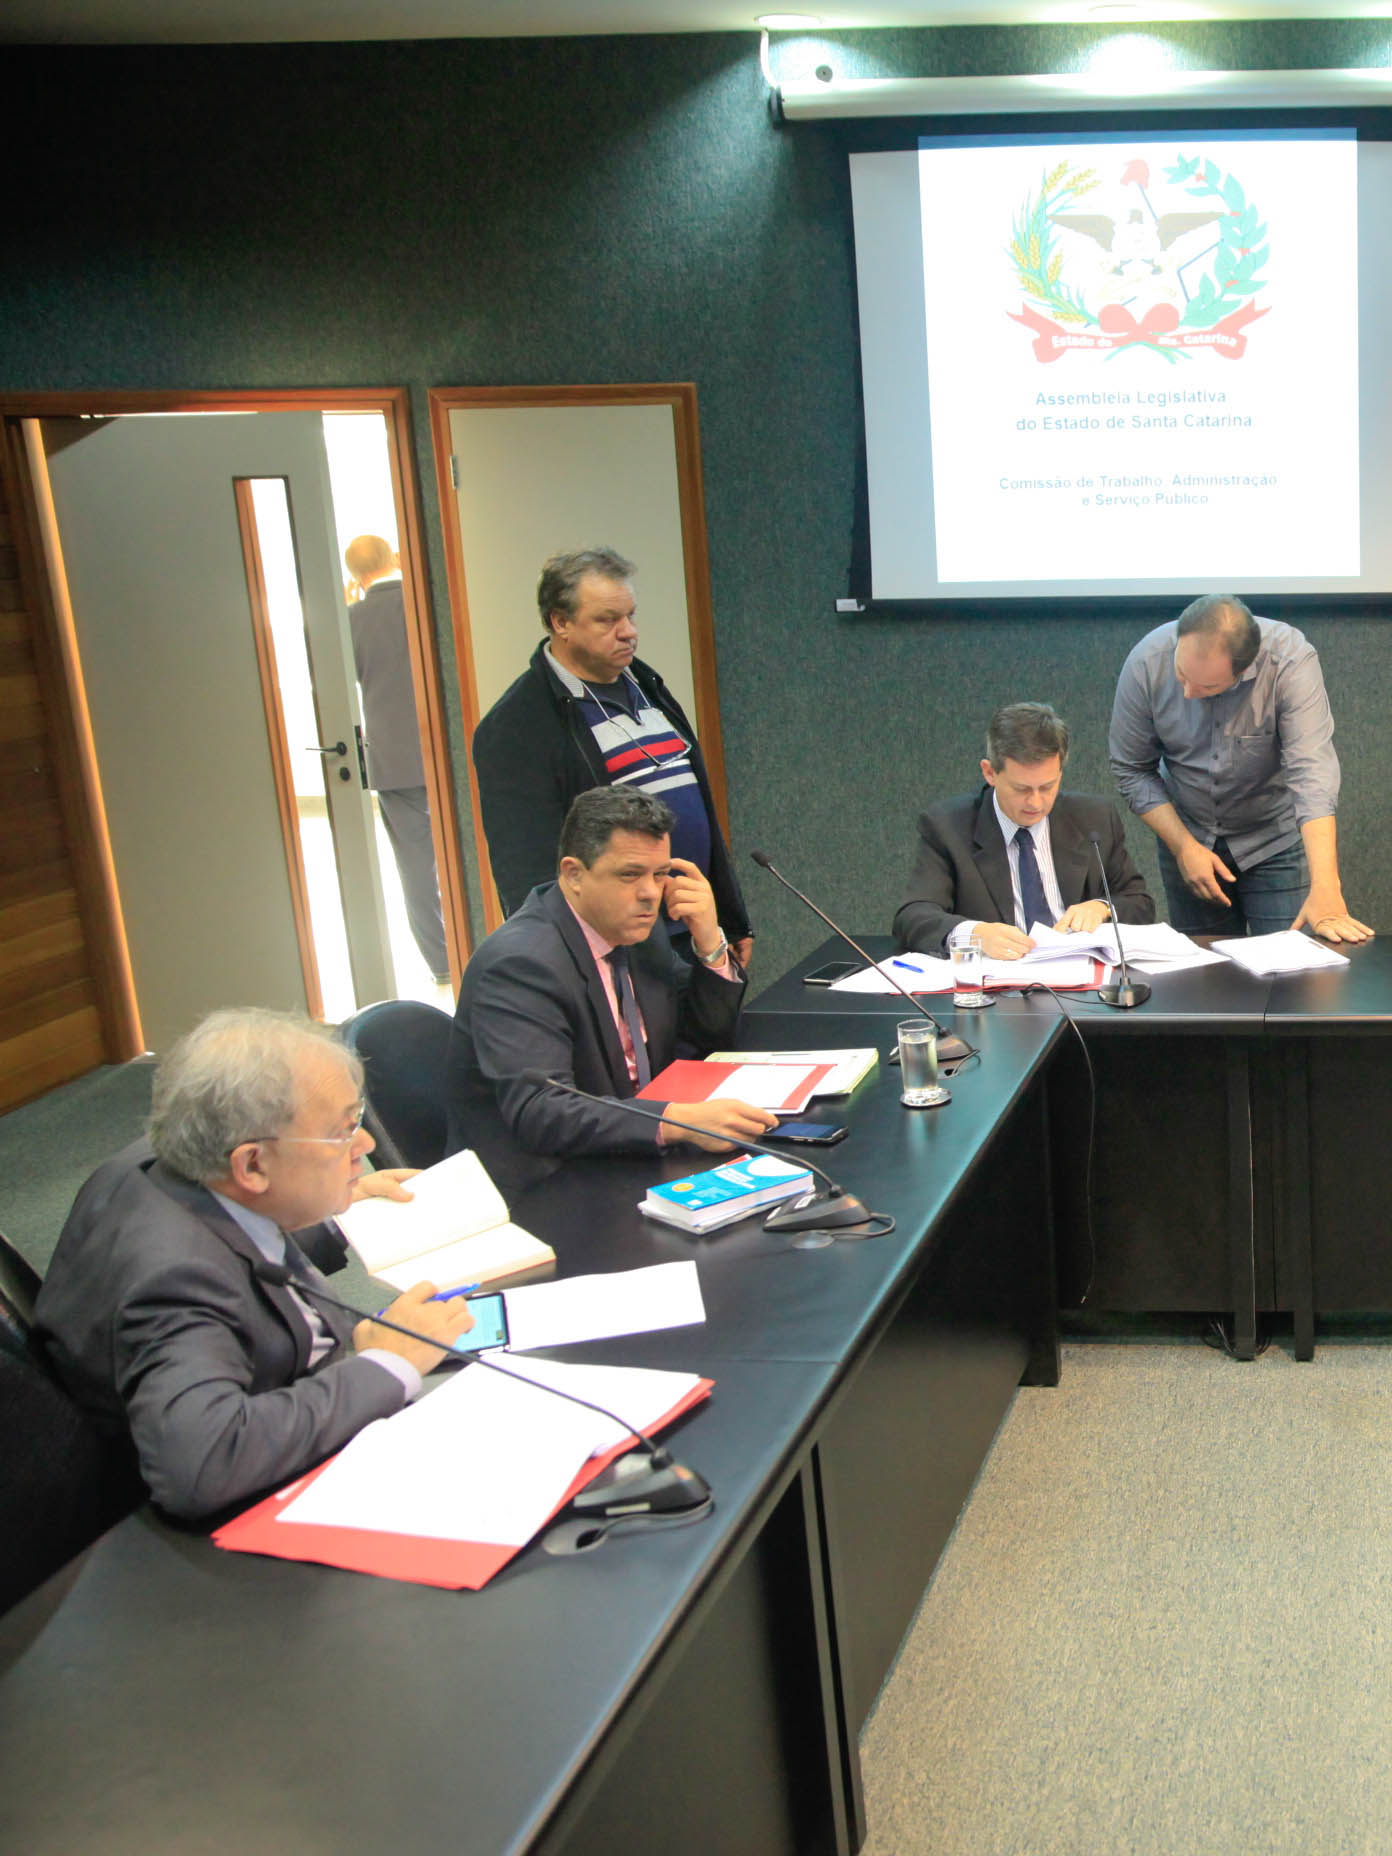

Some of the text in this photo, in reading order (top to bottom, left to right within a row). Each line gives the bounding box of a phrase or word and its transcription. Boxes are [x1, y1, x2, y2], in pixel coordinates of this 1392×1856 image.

[1035, 390, 1227, 407] Assembleia Legislativa
[1016, 413, 1253, 431] do Estado de Santa Catarina
[1076, 475, 1094, 488] de
[1095, 493, 1151, 507] Serviço
